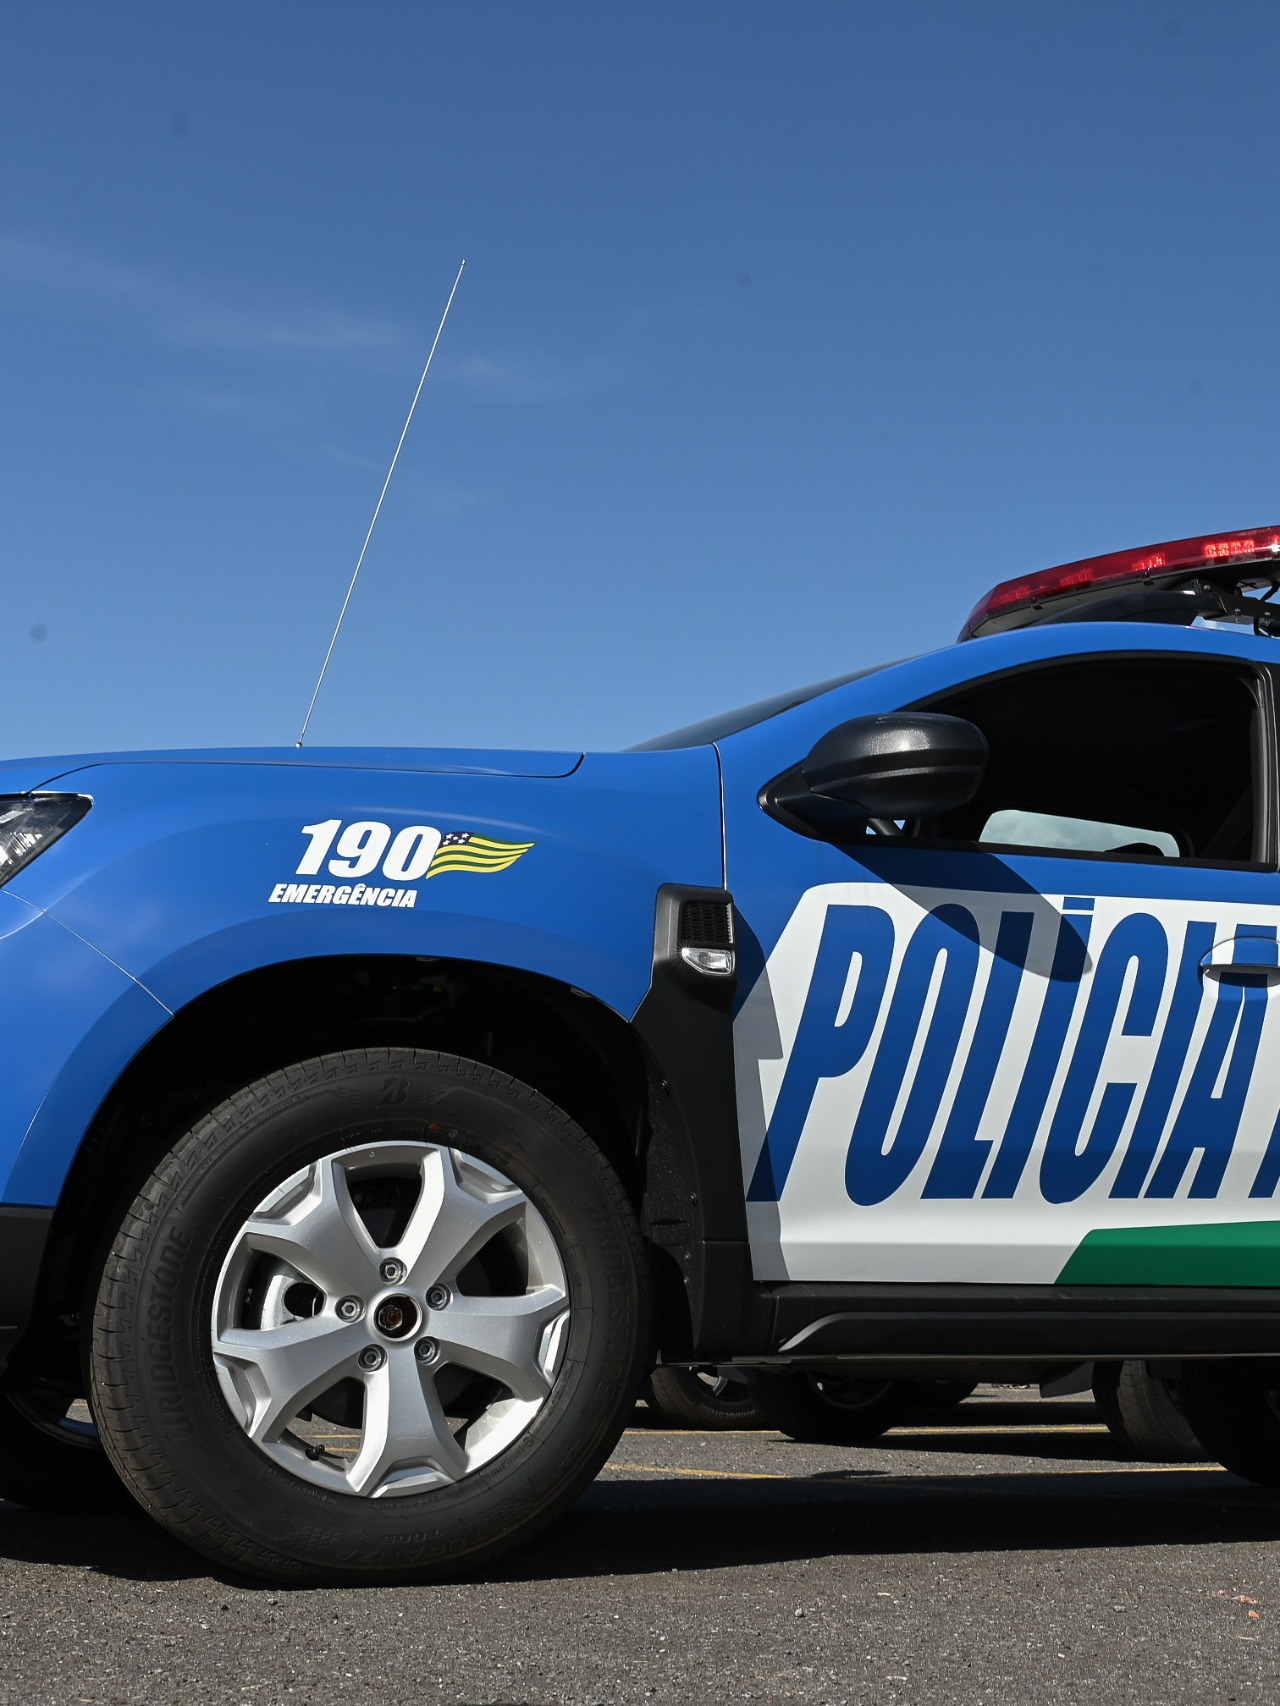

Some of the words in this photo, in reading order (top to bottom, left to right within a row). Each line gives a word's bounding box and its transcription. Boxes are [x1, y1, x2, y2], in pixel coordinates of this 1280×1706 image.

[294, 818, 443, 881] 190
[268, 883, 418, 908] EMERGÊNCIA
[745, 896, 1278, 1206] POLÍCIA
